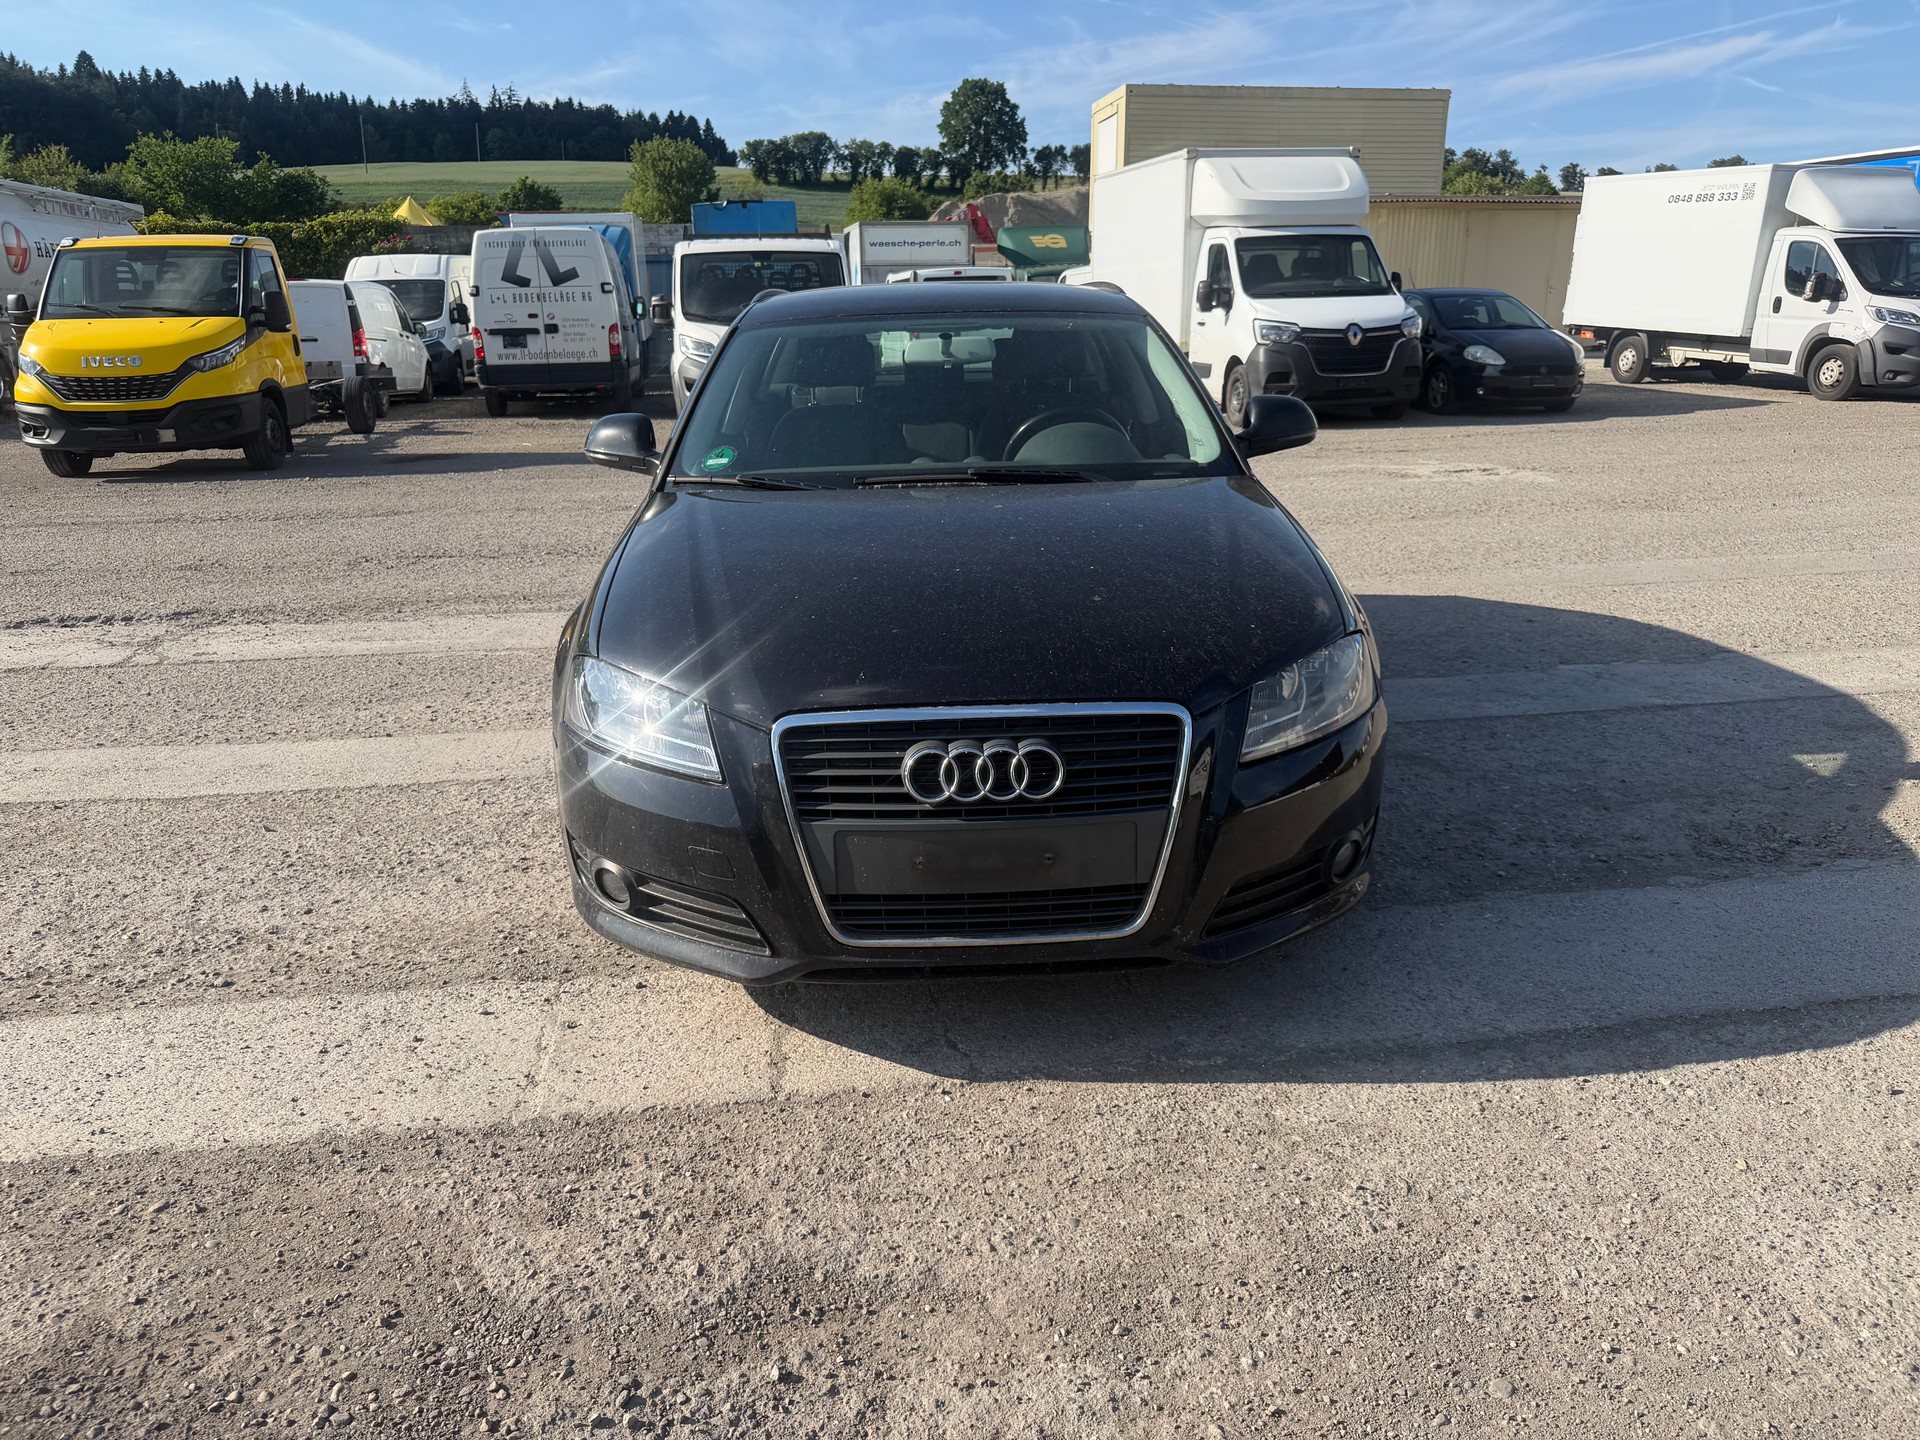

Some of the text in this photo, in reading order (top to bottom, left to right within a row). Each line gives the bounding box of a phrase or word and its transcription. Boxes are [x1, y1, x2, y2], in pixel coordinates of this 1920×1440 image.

[1668, 192, 1739, 204] 0848 888 333
[484, 240, 526, 249] FACHBETRIEB
[543, 238, 587, 248] BODENBELÄGE
[868, 239, 962, 249] waesche-perle.ch
[490, 290, 593, 304] L+L BODENBELÄGE AG
[497, 347, 599, 362] www.ll-bodenbelaege.ch
[81, 355, 142, 368] IVECO
